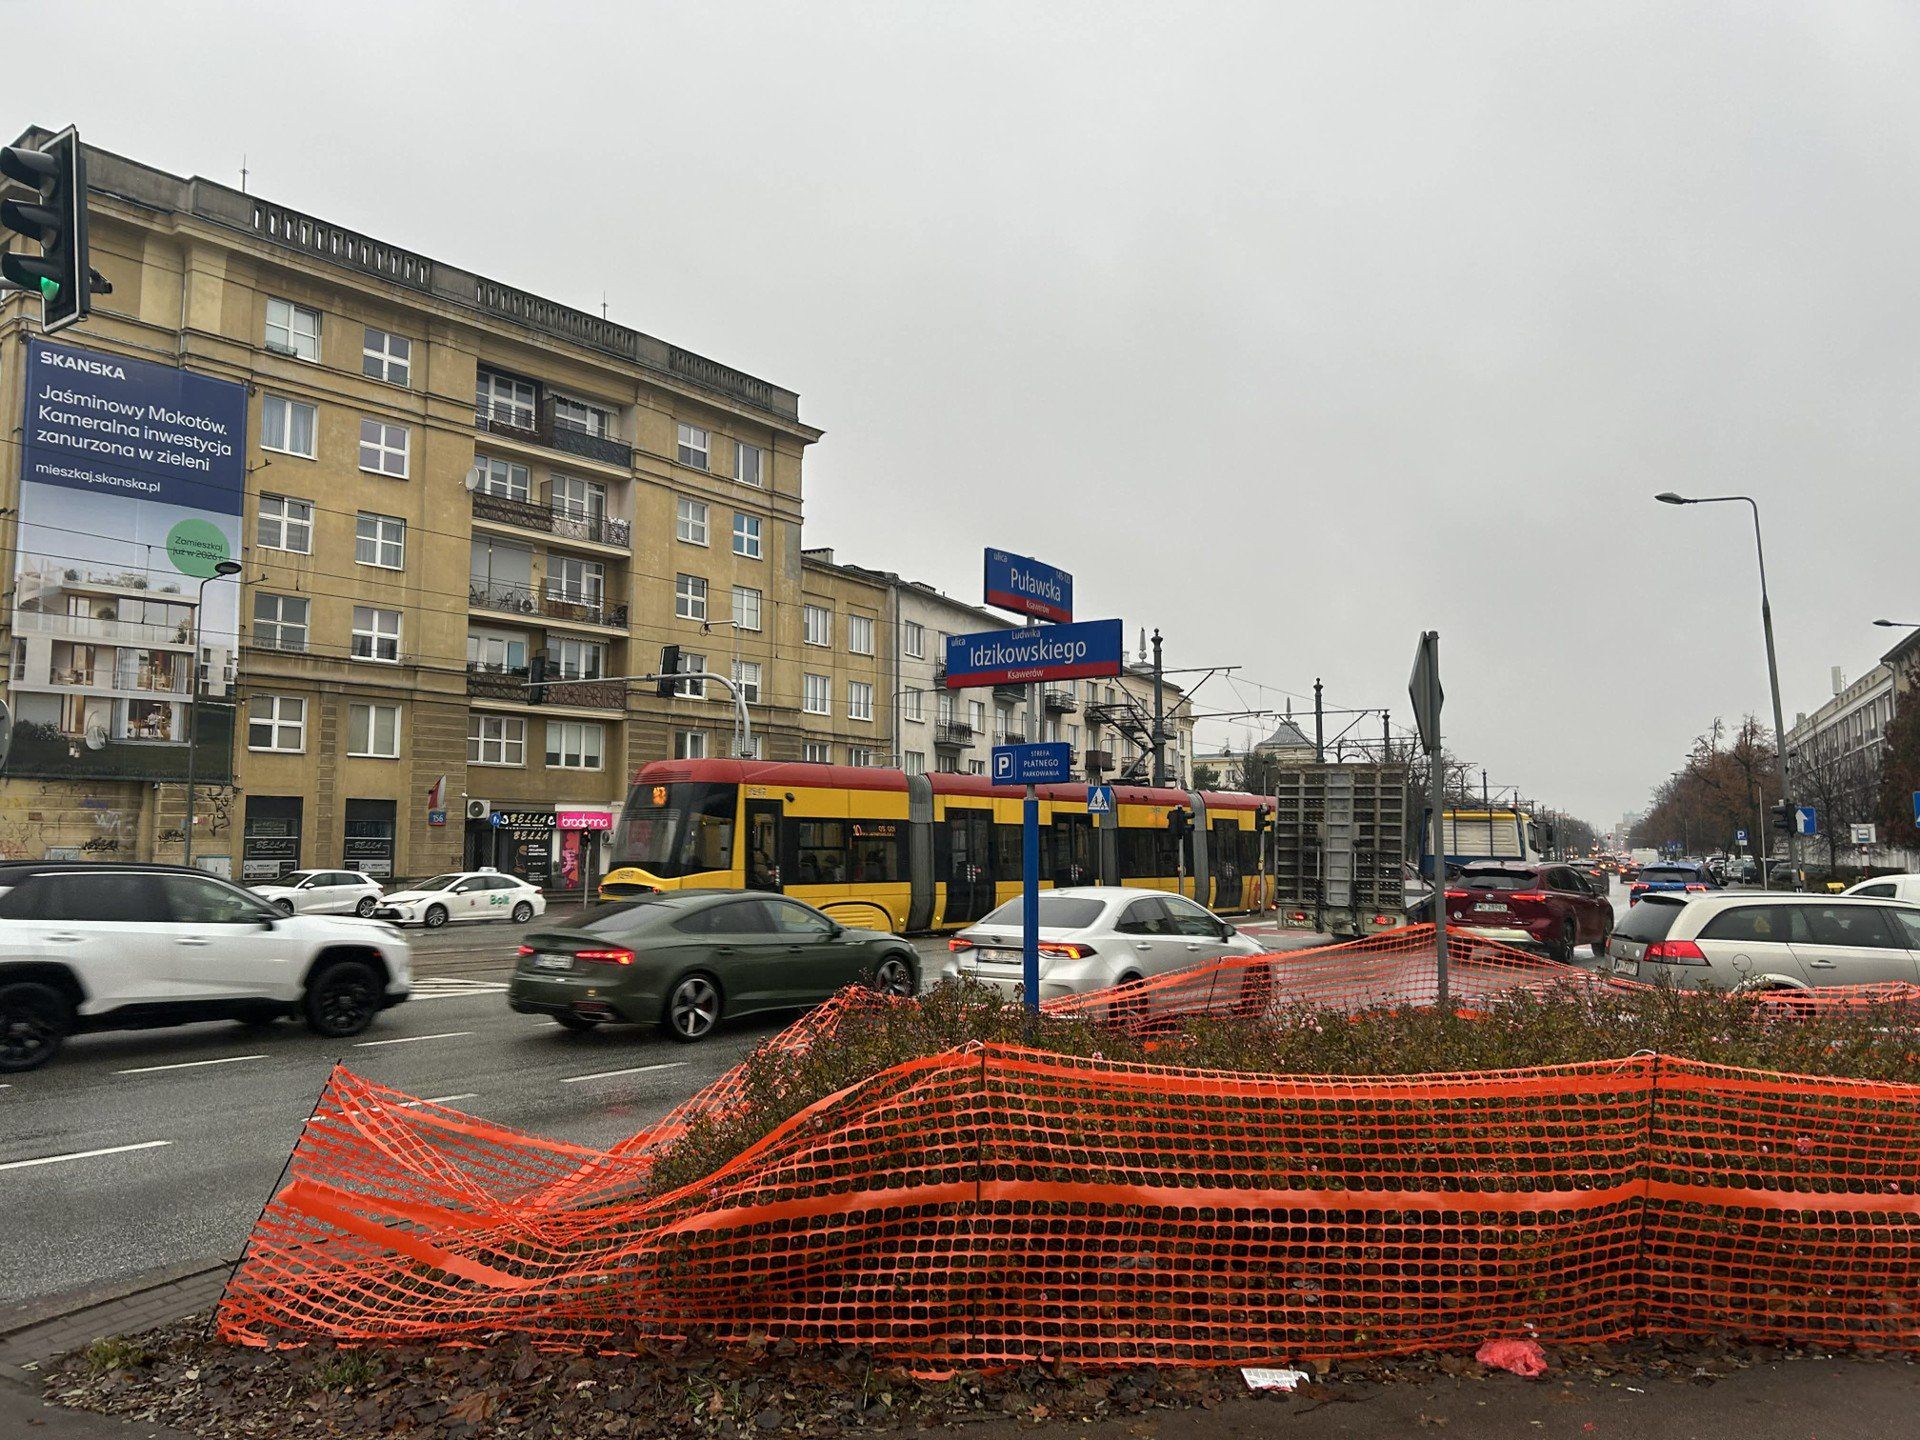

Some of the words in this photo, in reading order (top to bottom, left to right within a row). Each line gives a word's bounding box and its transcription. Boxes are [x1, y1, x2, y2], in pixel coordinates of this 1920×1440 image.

[40, 351, 126, 380] SKANSKA
[38, 385, 144, 420] Jaśminowy
[148, 405, 228, 436] Mokotów.
[38, 404, 140, 438] Kameralna
[144, 425, 232, 456] inwestycja
[36, 429, 135, 458] zanurzona
[139, 447, 154, 461] w
[157, 450, 211, 472] zieleni
[35, 462, 161, 493] mieszkaj.skanska.pl
[174, 535, 223, 553] Zamieszkaj
[993, 551, 1008, 563] ulica
[1010, 567, 1061, 602] Puławska
[1026, 599, 1050, 615] Ksawerów
[1011, 629, 1041, 640] Ludwika
[951, 637, 966, 647] ulica
[970, 639, 1087, 668] Idzikowskiego
[1007, 668, 1044, 680] Ksawerów
[998, 756, 1010, 775] P
[1023, 758, 1059, 767] PŁATNEGO
[1022, 770, 1060, 778] PARKOWANIA
[510, 813, 546, 824] BELLA
[513, 831, 549, 841] BELLA
[256, 841, 287, 849] BELLA
[354, 841, 383, 849] BELLA
[489, 894, 510, 905] Bolt
